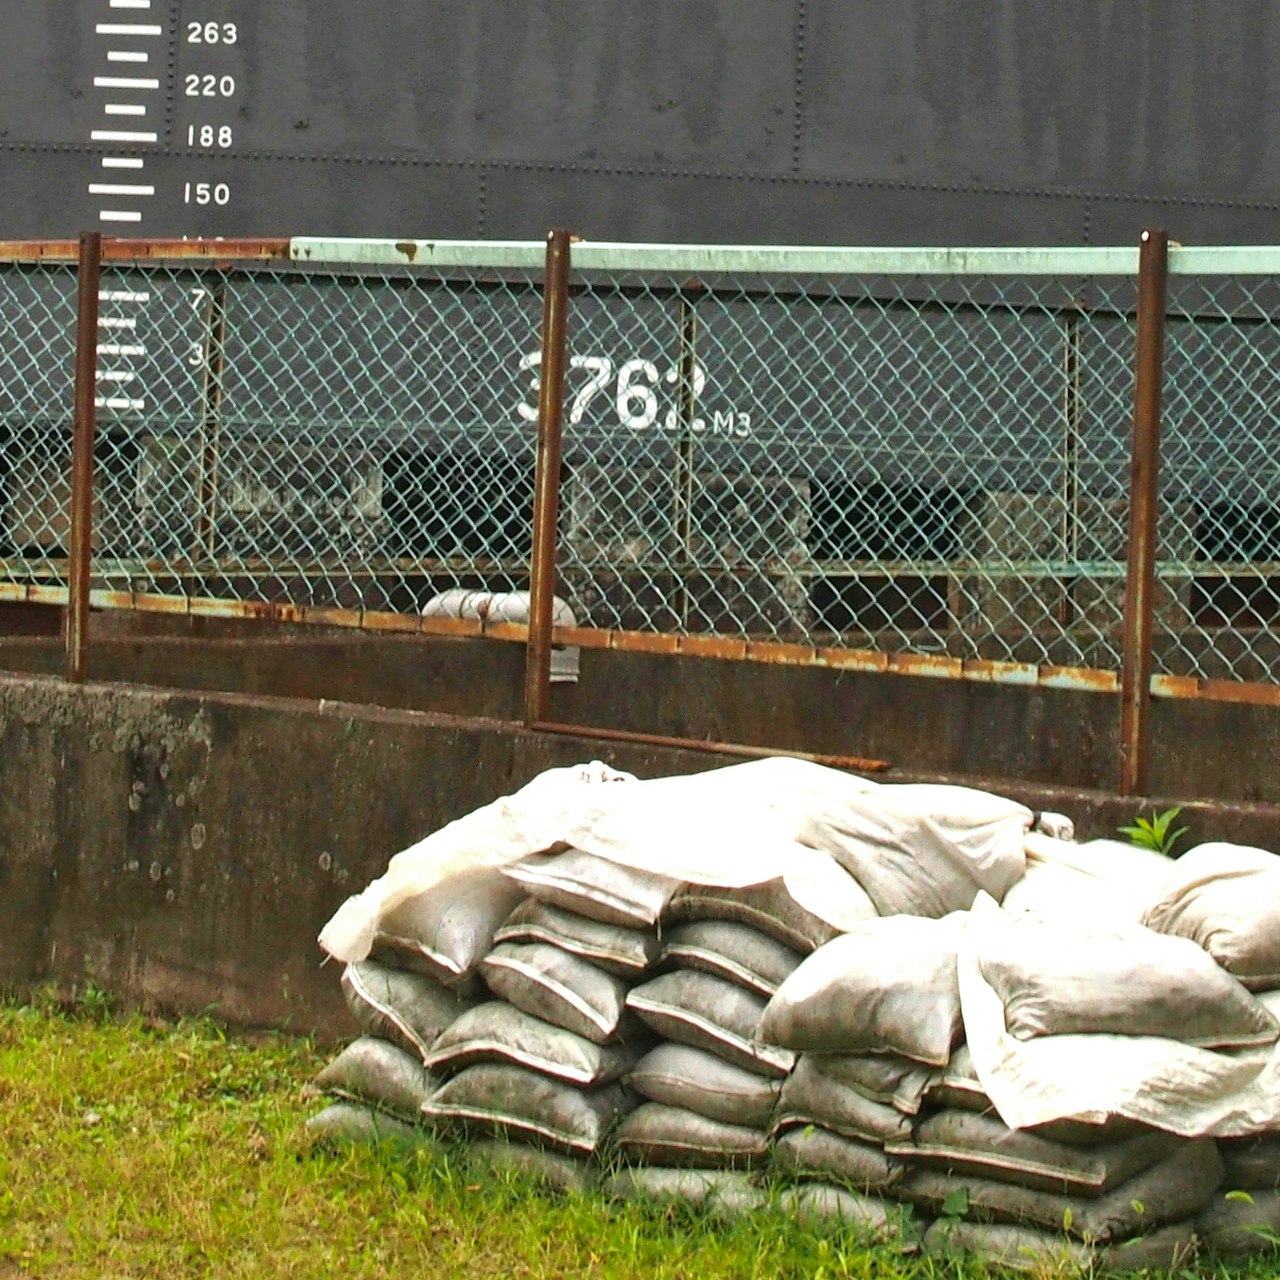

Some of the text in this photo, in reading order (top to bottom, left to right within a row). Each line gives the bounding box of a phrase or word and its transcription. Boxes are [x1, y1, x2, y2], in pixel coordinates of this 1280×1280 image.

[188, 22, 237, 44] 263
[186, 74, 234, 96] 220
[189, 125, 232, 147] 188
[185, 183, 229, 205] 150
